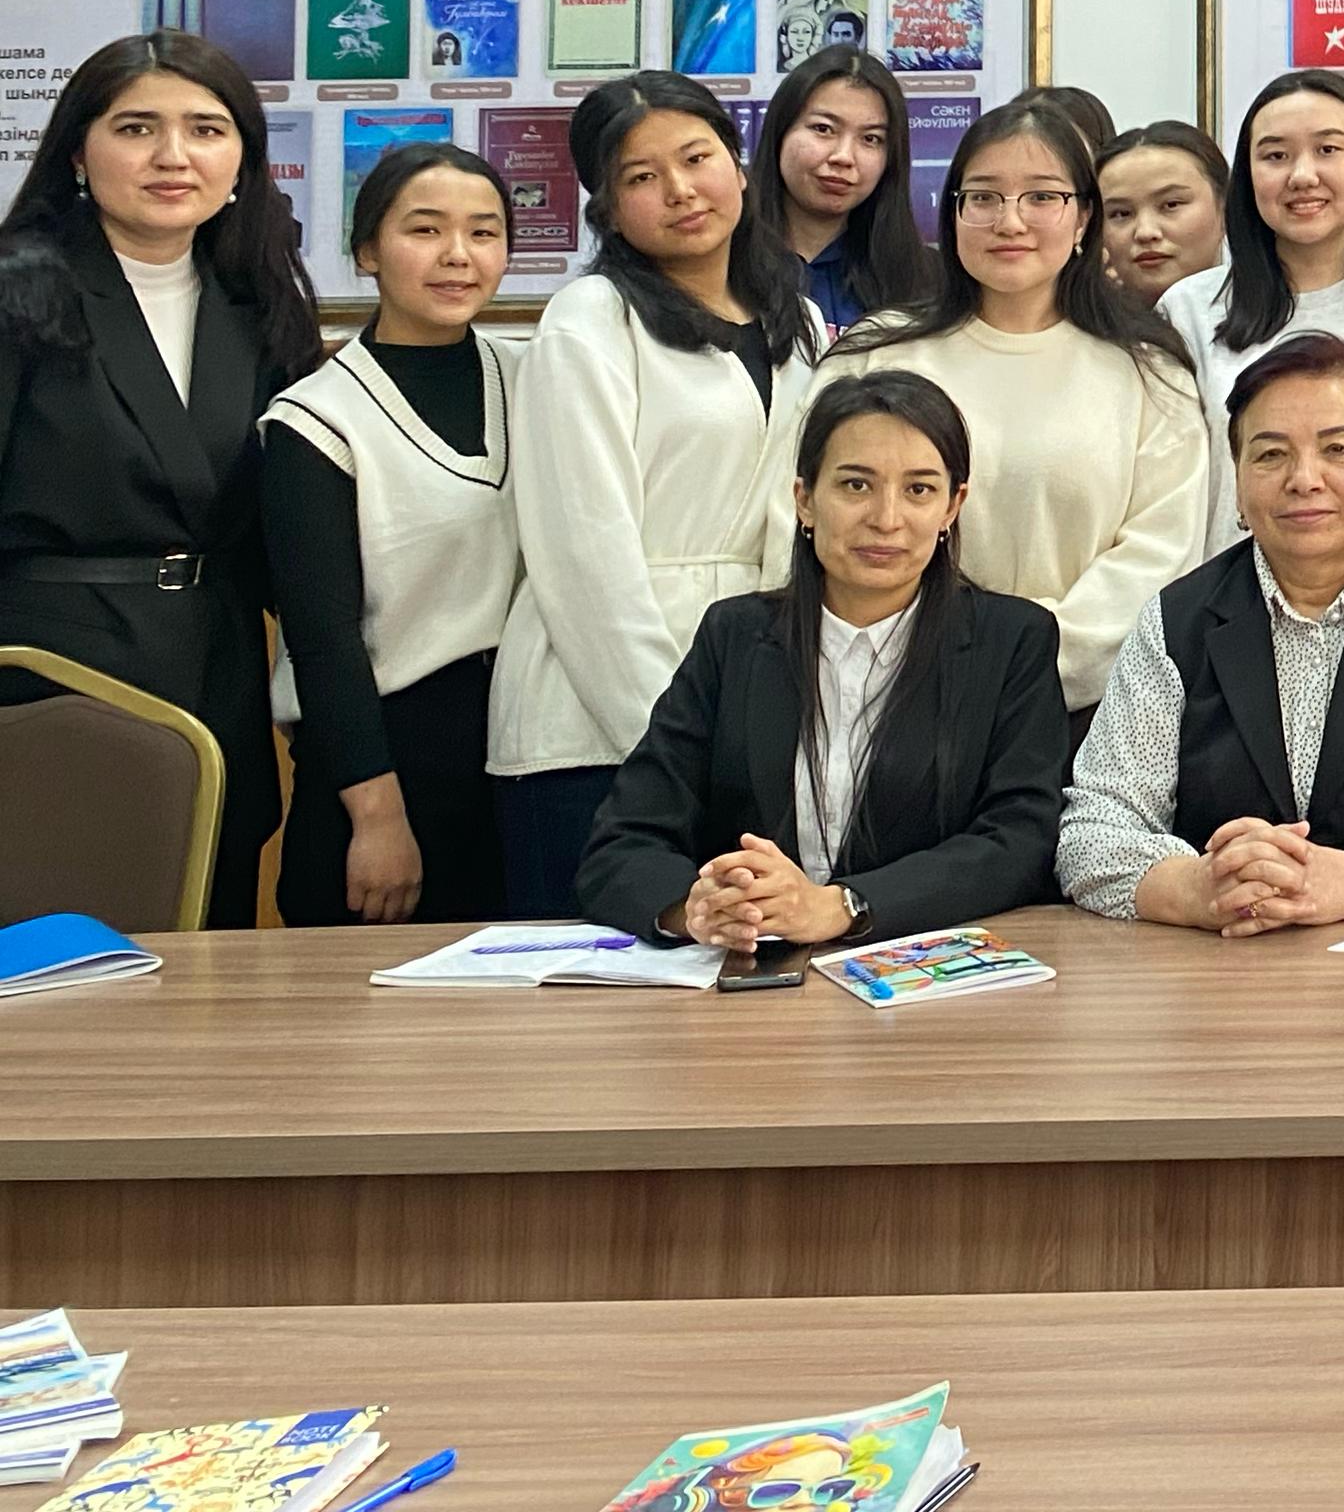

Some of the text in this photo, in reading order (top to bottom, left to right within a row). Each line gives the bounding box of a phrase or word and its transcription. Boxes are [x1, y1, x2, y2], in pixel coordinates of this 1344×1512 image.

[51, 68, 72, 81] де
[931, 106, 970, 116] СӘКЕН
[908, 117, 971, 128] ЕЙФУЛЛИН
